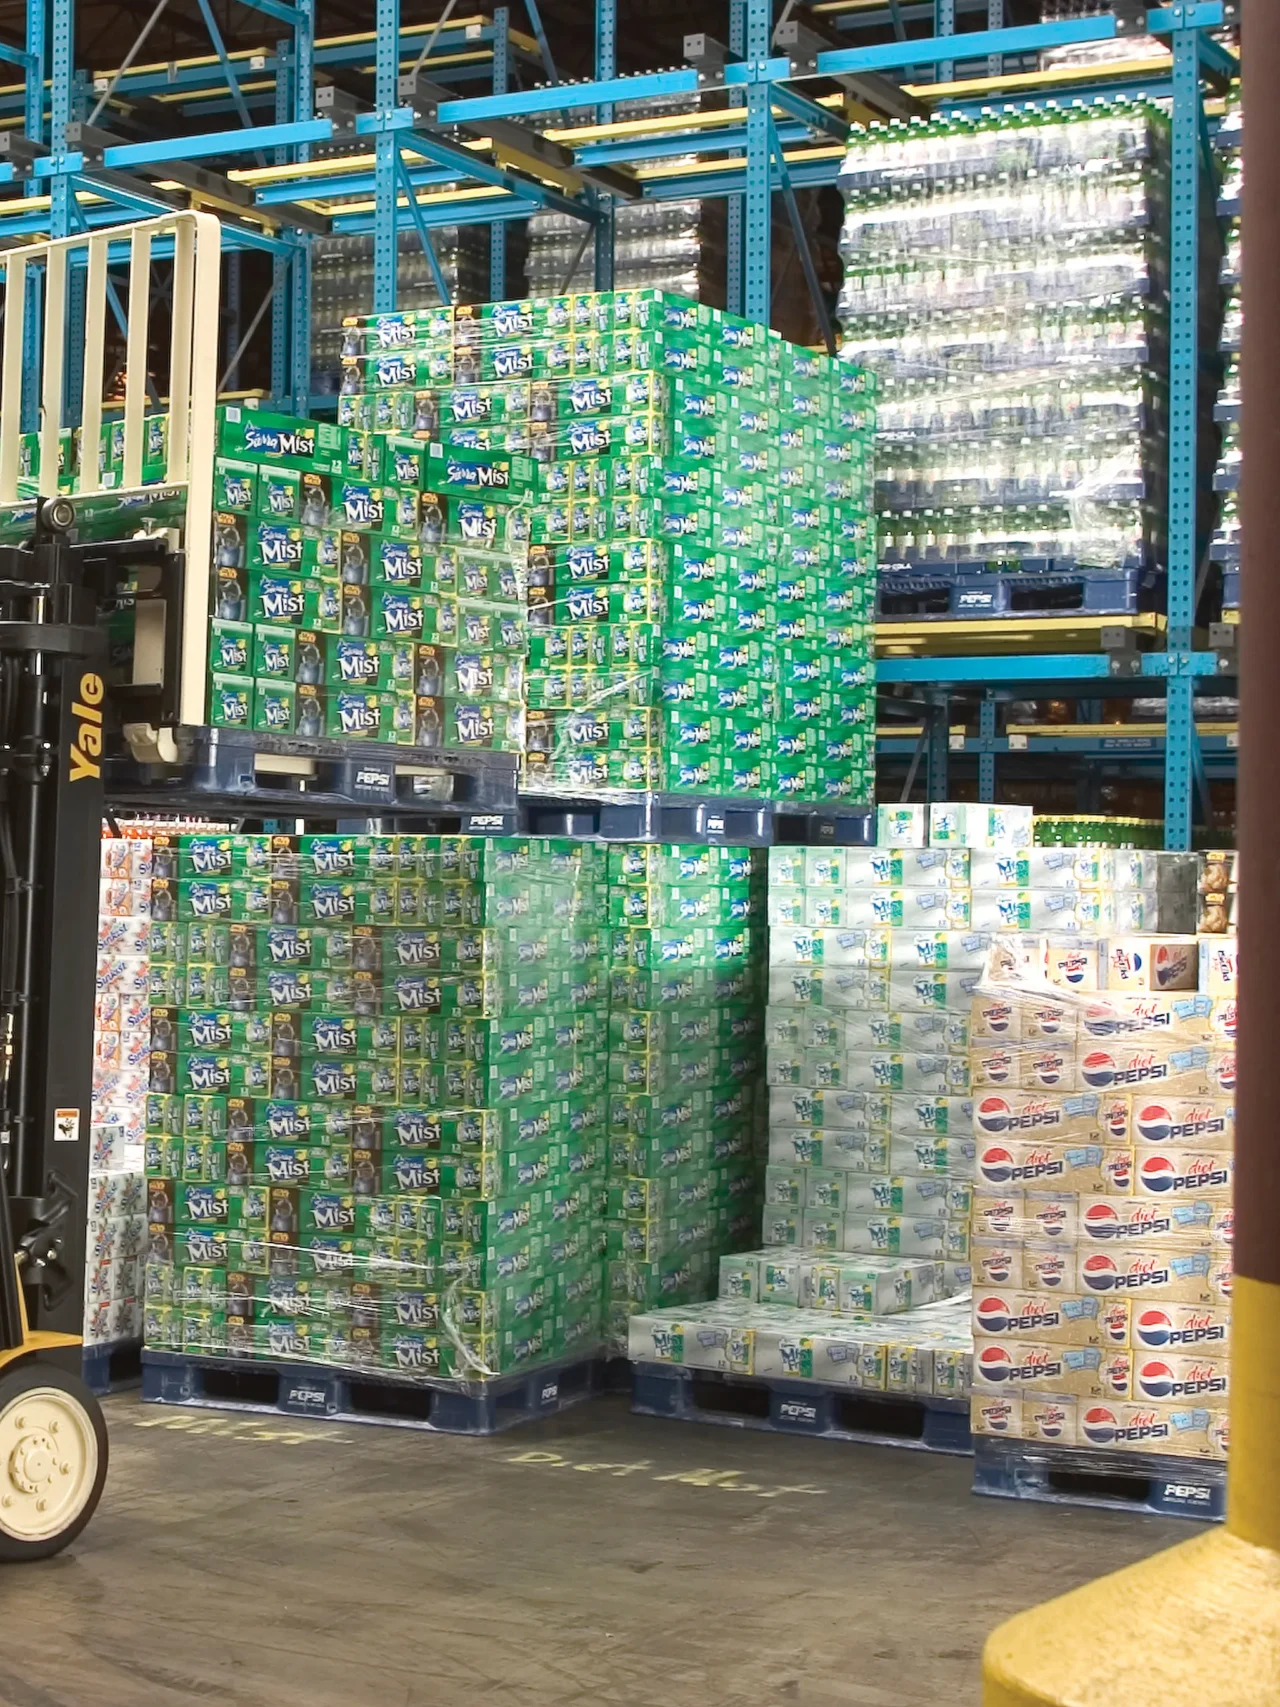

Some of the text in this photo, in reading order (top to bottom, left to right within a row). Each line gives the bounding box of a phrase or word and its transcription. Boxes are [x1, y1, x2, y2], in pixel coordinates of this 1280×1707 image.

[493, 312, 535, 338] Mist
[376, 364, 417, 388] Mist
[493, 354, 534, 379] Mist
[450, 398, 492, 423] Mist
[570, 388, 612, 413] Mist
[244, 430, 315, 456] Sierra Mist
[569, 429, 611, 454] Mist
[447, 466, 510, 489] Sierra Mist
[344, 500, 385, 524] Mist
[460, 516, 498, 540] Mist
[259, 540, 304, 566] Mist
[381, 557, 424, 582] Mist
[569, 556, 611, 581] Mist
[261, 594, 306, 621] Mist
[568, 598, 611, 621] Mist
[383, 609, 424, 636] Mist
[338, 655, 381, 682] Mist
[455, 663, 494, 692] Mist
[69, 673, 104, 782] Yale
[338, 705, 381, 735] Mist
[456, 717, 495, 747] Mist
[570, 722, 610, 746] Mist
[357, 772, 390, 786] PEPSI
[192, 850, 233, 875] Mist
[313, 851, 355, 875] Mist
[190, 892, 232, 918] Mist
[311, 895, 355, 919] Mist
[269, 940, 312, 965] Mist
[396, 942, 442, 966] Mist
[269, 982, 312, 1008] Mist
[396, 987, 442, 1012] Mist
[190, 1023, 232, 1048] Mist
[314, 1029, 359, 1053] Mist
[1128, 1053, 1157, 1070] diet
[189, 1065, 231, 1092] Mist
[314, 1071, 358, 1098] Mist
[1113, 1064, 1168, 1085] PEPSI
[1008, 1109, 1061, 1131] PEPSI
[1022, 1101, 1051, 1115] diet
[1184, 1107, 1213, 1123] diet
[268, 1115, 311, 1141] Mist
[396, 1123, 442, 1147] Mist
[1169, 1118, 1225, 1140] PEPSI
[267, 1157, 311, 1183] Mist
[1025, 1151, 1053, 1166] diet
[1188, 1159, 1216, 1175] diet
[394, 1166, 441, 1191] Mist
[1011, 1161, 1064, 1181] PEPSI
[1173, 1170, 1228, 1190] PEPSI
[187, 1195, 230, 1221] Mist
[312, 1205, 356, 1232] Mist
[1131, 1207, 1158, 1223] diet
[1117, 1218, 1170, 1239] PEPSI
[188, 1238, 229, 1264] Mist
[1129, 1258, 1158, 1275] diet
[1114, 1270, 1169, 1290] PEPSI
[396, 1301, 440, 1327] Mist
[1021, 1300, 1048, 1317] diet
[1007, 1312, 1059, 1331] PEPSI
[1184, 1313, 1212, 1330] diet
[1169, 1325, 1224, 1345] PEPSI
[396, 1344, 440, 1369] Mist
[1024, 1350, 1049, 1367] diet
[1009, 1362, 1061, 1381] PEPSI
[1186, 1365, 1215, 1382] diet
[1171, 1378, 1226, 1397] PEPSI
[780, 1404, 816, 1418] PEPSI
[1129, 1410, 1157, 1428] diet
[1114, 1424, 1168, 1442] PEPSI
[1164, 1484, 1211, 1500] PEPSI
